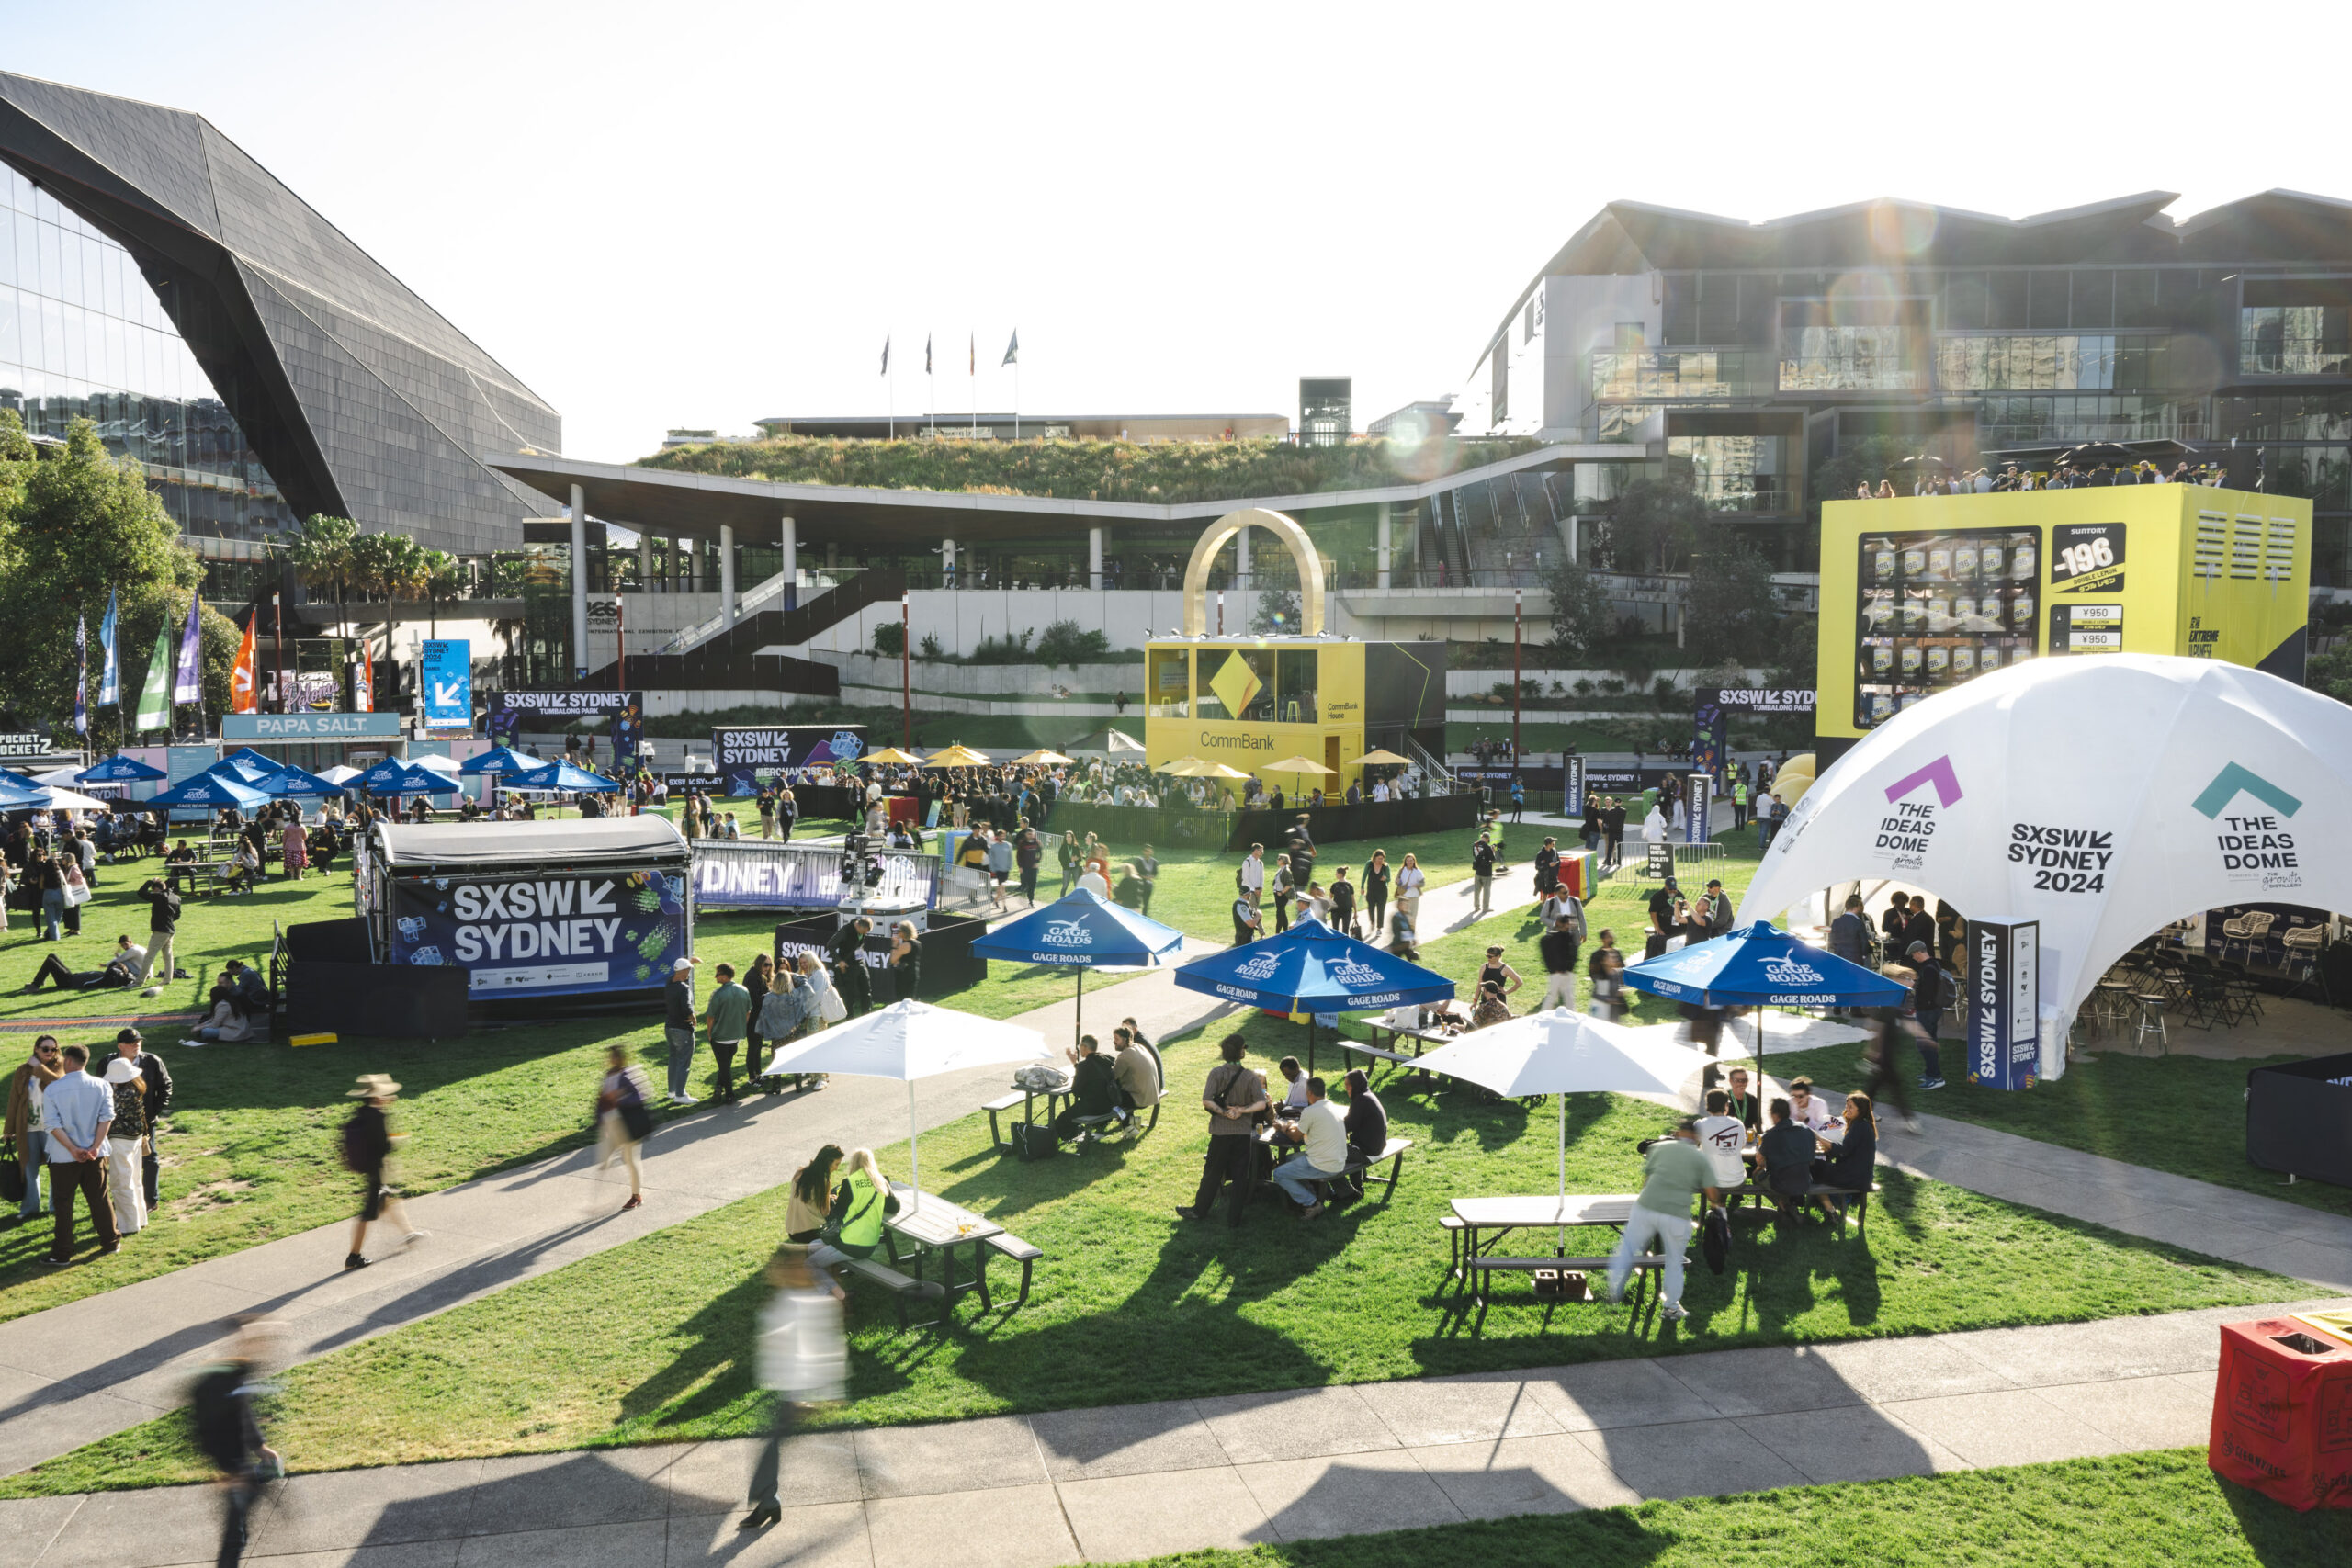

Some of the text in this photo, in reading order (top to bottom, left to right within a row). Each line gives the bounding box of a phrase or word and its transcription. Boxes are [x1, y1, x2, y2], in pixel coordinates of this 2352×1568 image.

[2053, 536, 2114, 577] -196
[2073, 568, 2118, 585] DOUBLE LEMON
[2083, 609, 2109, 617] ¥950
[2082, 635, 2108, 644] ¥950
[282, 681, 340, 713] Paloma
[504, 693, 631, 708] SXSW SYDNEY
[1719, 689, 1764, 705] SXSW
[1327, 702, 1359, 712] CommBank
[1327, 712, 1345, 720] House
[256, 717, 368, 733] PAPA SALT
[723, 731, 773, 748] SXSW
[1200, 731, 1275, 750] CommBank
[723, 747, 791, 764] SYDNEY
[1584, 773, 1634, 782] XSW SYDNEY
[1569, 759, 1578, 813] SXSW SYDNEY
[1695, 780, 1703, 813] SYDNEY
[1899, 802, 1935, 818] THE
[1880, 818, 1936, 836] IDEAS
[2224, 816, 2278, 831] THE
[1875, 834, 1929, 852] DOME
[2011, 823, 2088, 848] SXSW
[2217, 833, 2294, 851] IDEAS
[1892, 855, 1924, 870] growth
[2007, 842, 2114, 871] SYDNEY
[2223, 852, 2299, 870] DOME
[2033, 870, 2105, 894] 2024
[2262, 871, 2302, 891] growth
[454, 879, 576, 921] SXSW
[1041, 933, 1093, 945] ROADS
[1048, 926, 1091, 937] GAGE
[455, 918, 622, 962] SYDNEY
[1032, 953, 1091, 964] GAGE ROADS
[1248, 957, 1282, 972] GAGE
[1234, 964, 1275, 979] ROADS
[1333, 964, 1374, 976] GAGE
[1764, 971, 1825, 984] ROADS
[1766, 964, 1815, 975] GAGE
[1336, 972, 1385, 985] ROADS
[1216, 983, 1258, 1000] GAGE ROADS
[1652, 980, 1681, 994] GAGE ROADS
[1347, 993, 1401, 1006] GAGE ROADS
[1770, 994, 1836, 1004] GAGE ROADS
[1980, 930, 1997, 1078] SXSW SYDNEY
[2012, 1043, 2030, 1055] SXSW
[2012, 1050, 2036, 1064] SYDNEY
